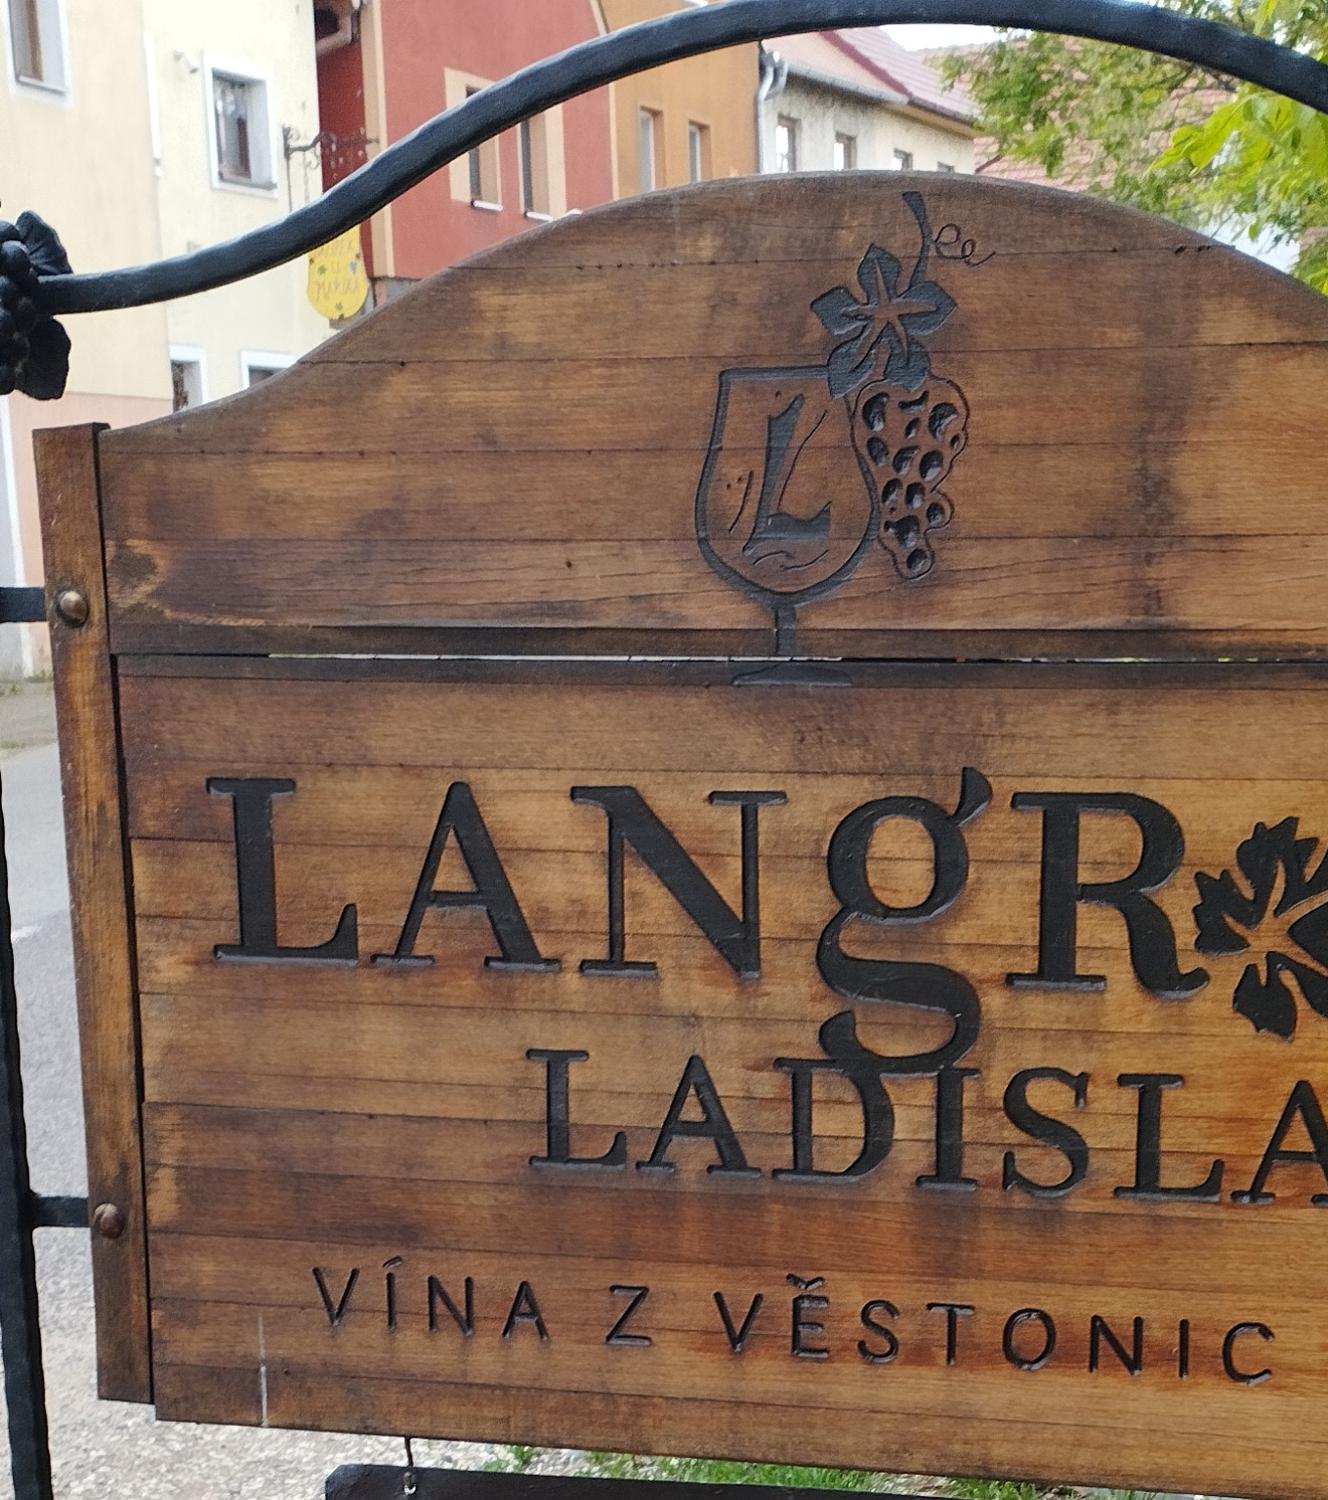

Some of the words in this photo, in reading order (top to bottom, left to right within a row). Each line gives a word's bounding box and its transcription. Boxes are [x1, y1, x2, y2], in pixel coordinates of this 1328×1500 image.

[310, 1256, 552, 1344] VÍNA
[606, 1283, 655, 1349] Z
[713, 1273, 1278, 1387] VĚSTONIC
